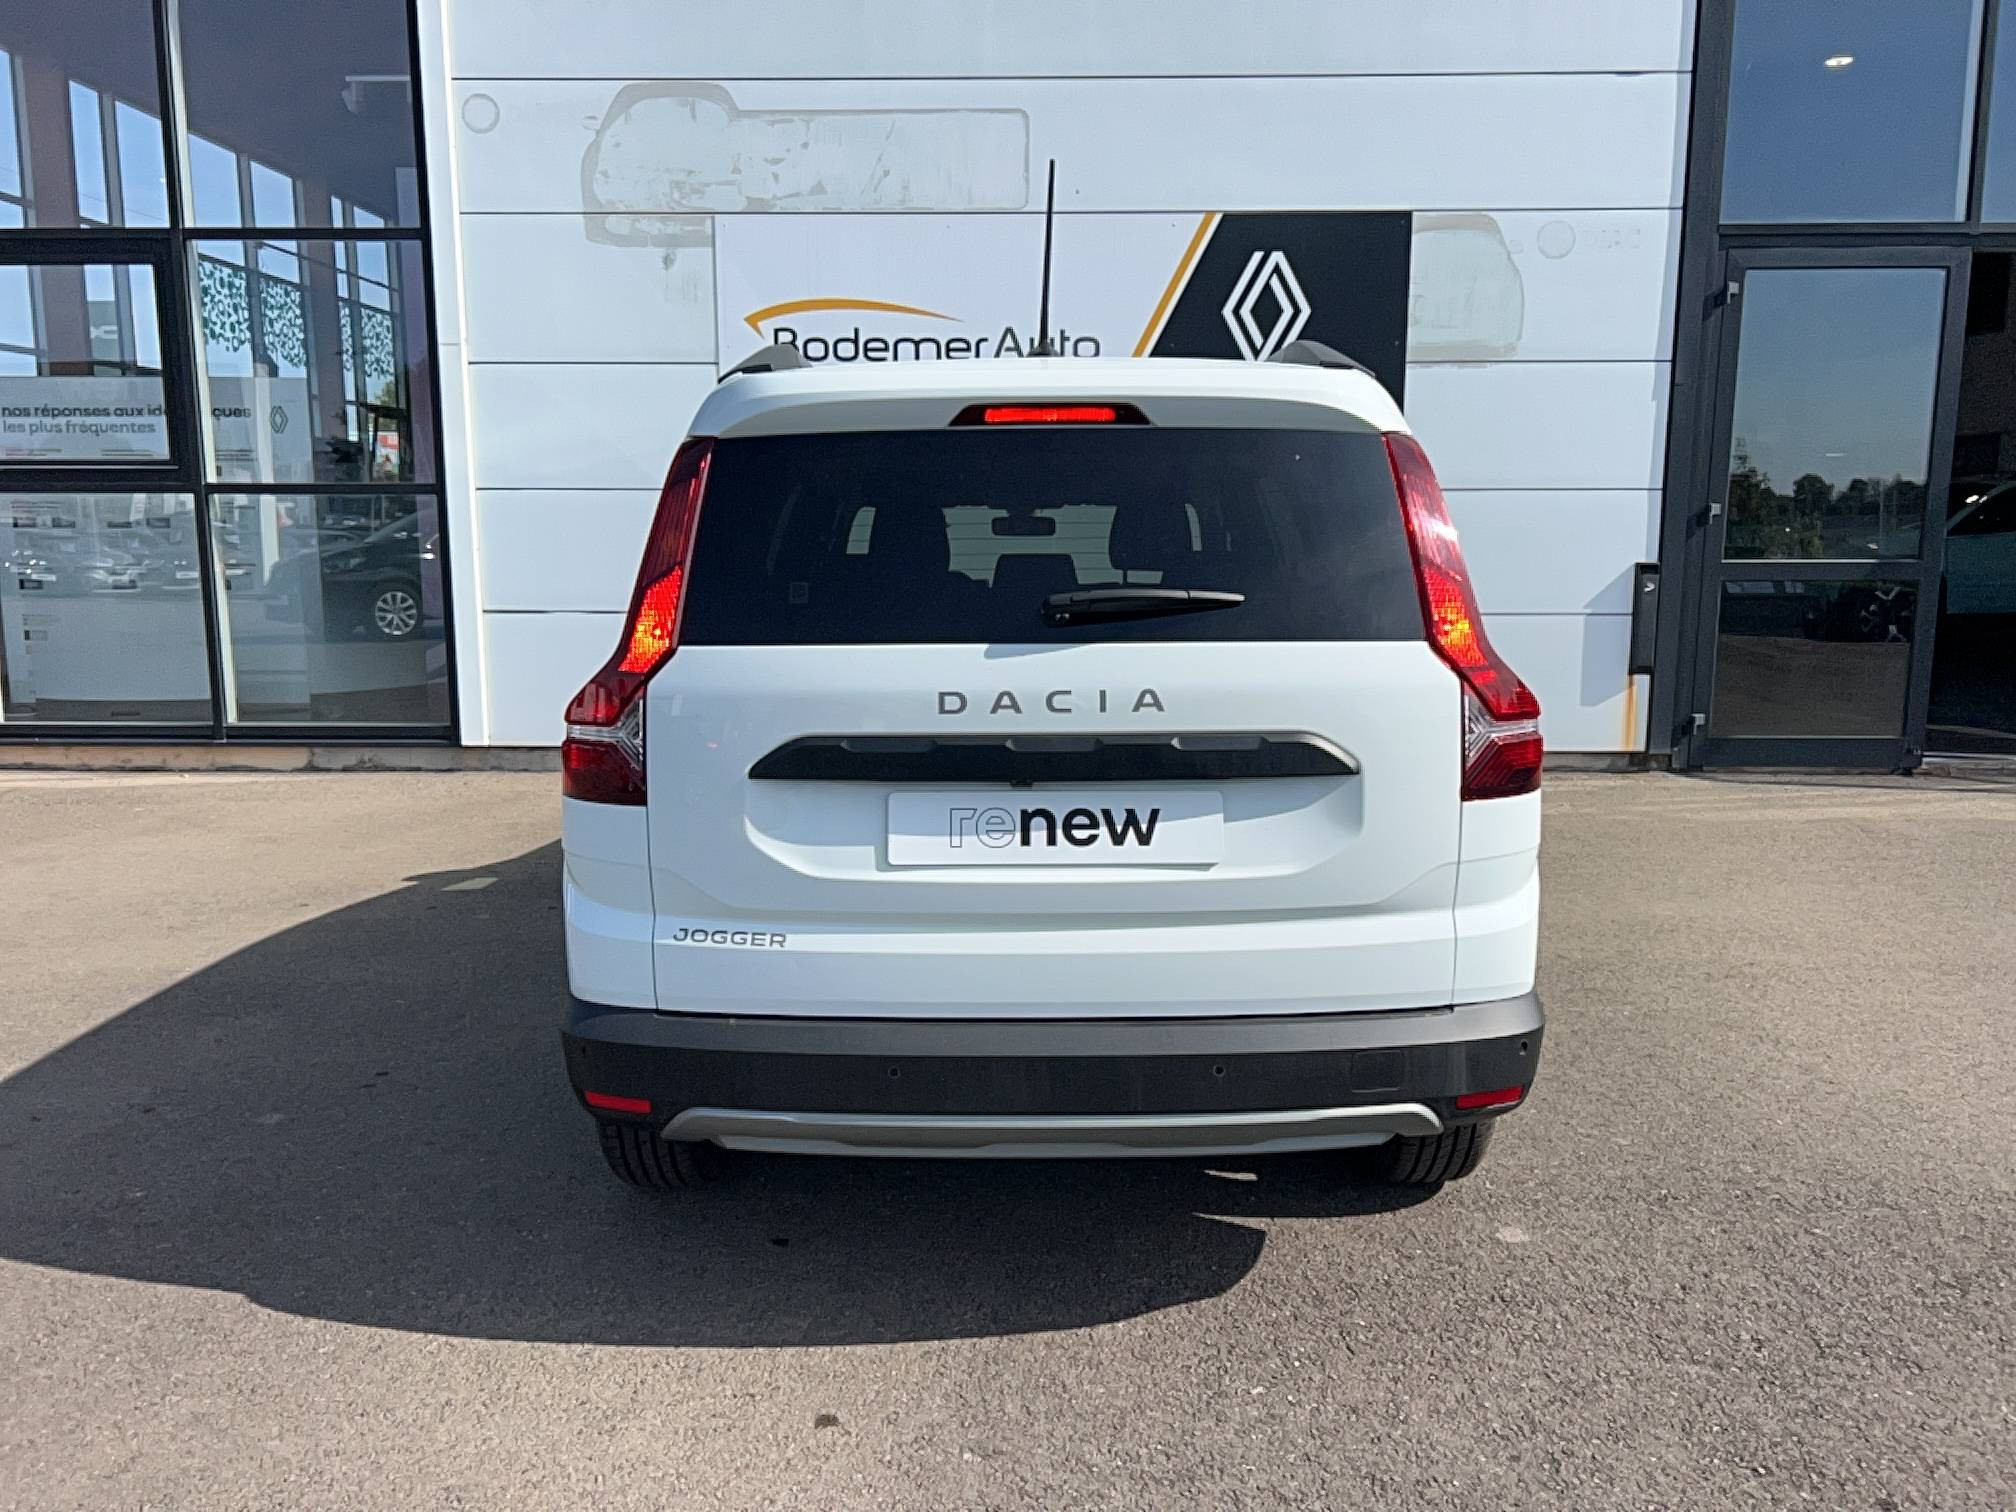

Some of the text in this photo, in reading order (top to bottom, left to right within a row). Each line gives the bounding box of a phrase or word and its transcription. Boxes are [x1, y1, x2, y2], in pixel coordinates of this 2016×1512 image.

[2, 406, 31, 417] nos
[34, 403, 110, 419] réponses
[113, 406, 144, 417] aux
[3, 420, 156, 436] les plus fréquentes
[938, 688, 1165, 715] DACIA
[949, 807, 1161, 849] renew
[673, 927, 787, 948] JOGGER
